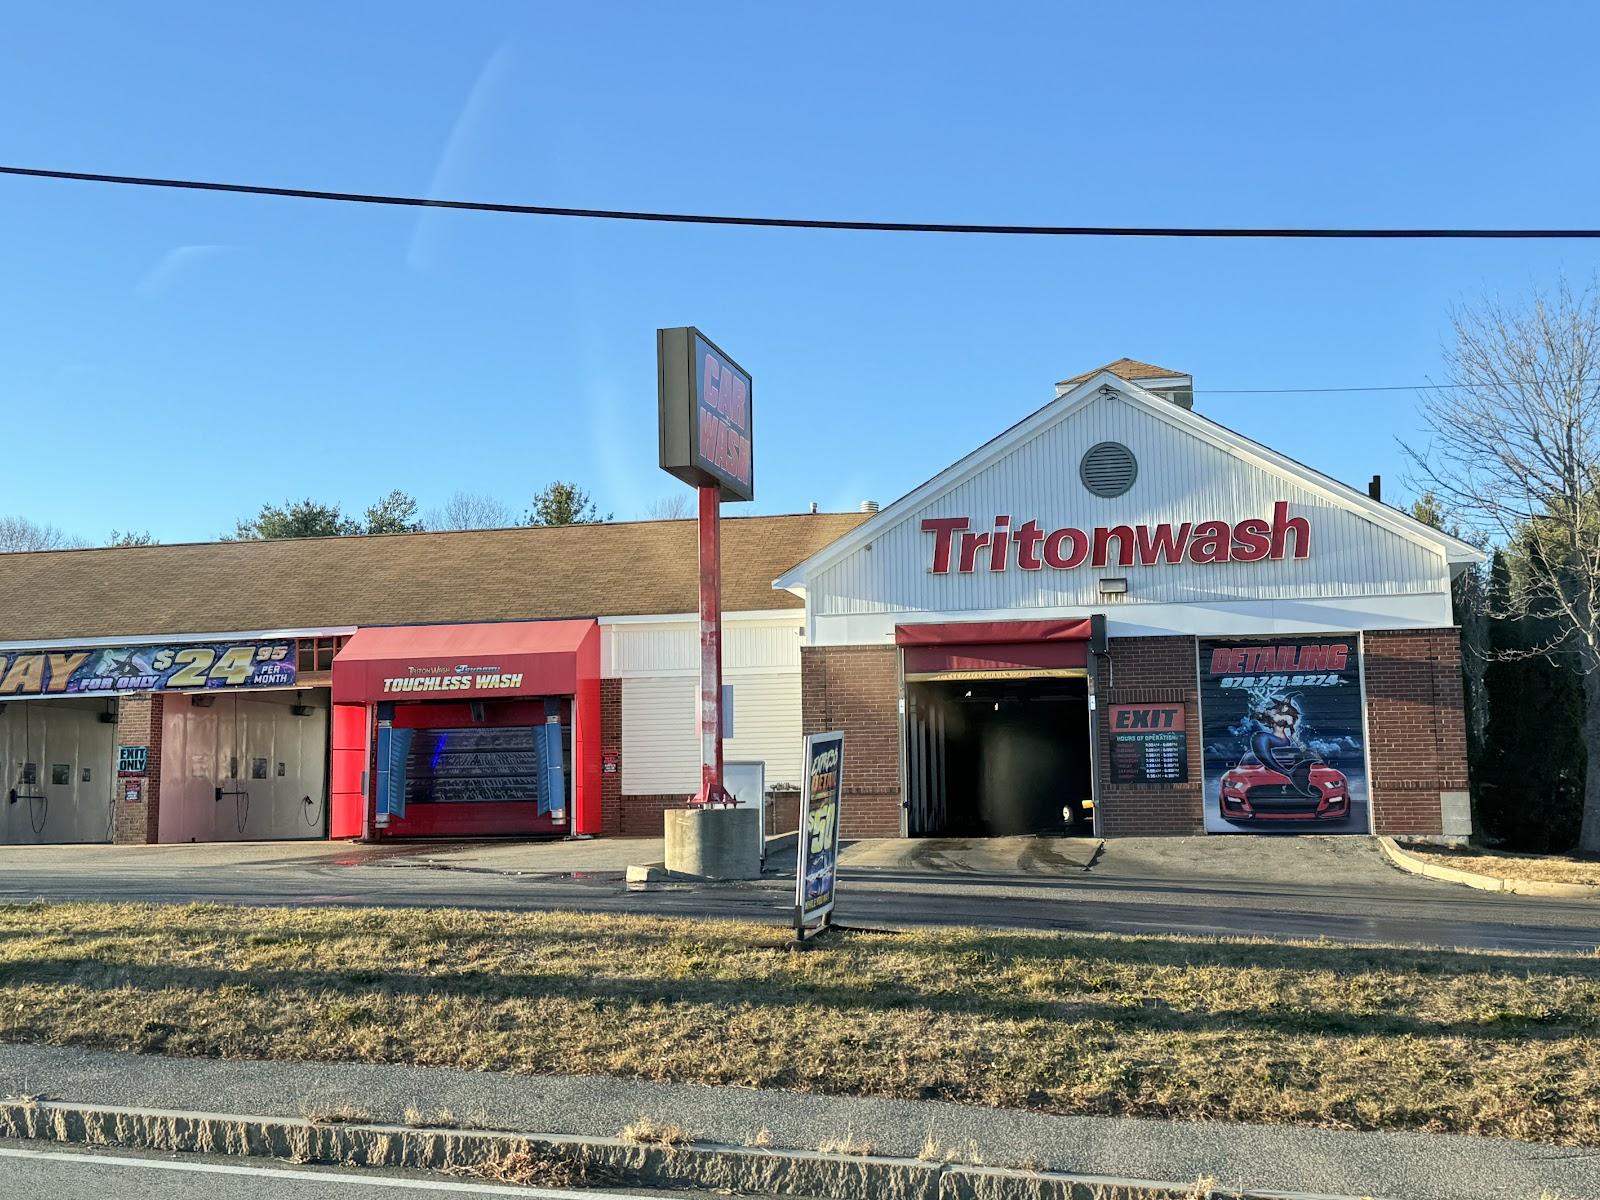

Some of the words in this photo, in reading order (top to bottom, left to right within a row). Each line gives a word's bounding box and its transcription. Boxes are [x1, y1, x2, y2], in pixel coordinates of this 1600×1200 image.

[703, 353, 746, 430] CAR
[699, 406, 750, 486] WASH
[920, 500, 1312, 575] Tritonwash
[256, 646, 289, 661] 95
[1210, 644, 1349, 674] DETAILING
[261, 665, 281, 674] PER
[79, 677, 114, 691] FOR
[116, 674, 161, 690] ONLY
[253, 674, 288, 684] MONTH
[383, 675, 473, 693] TOUCHLESS
[475, 673, 523, 690] WASH
[1115, 709, 1178, 729] EXIT
[120, 748, 146, 760] EXIT
[119, 759, 146, 771] ONLY
